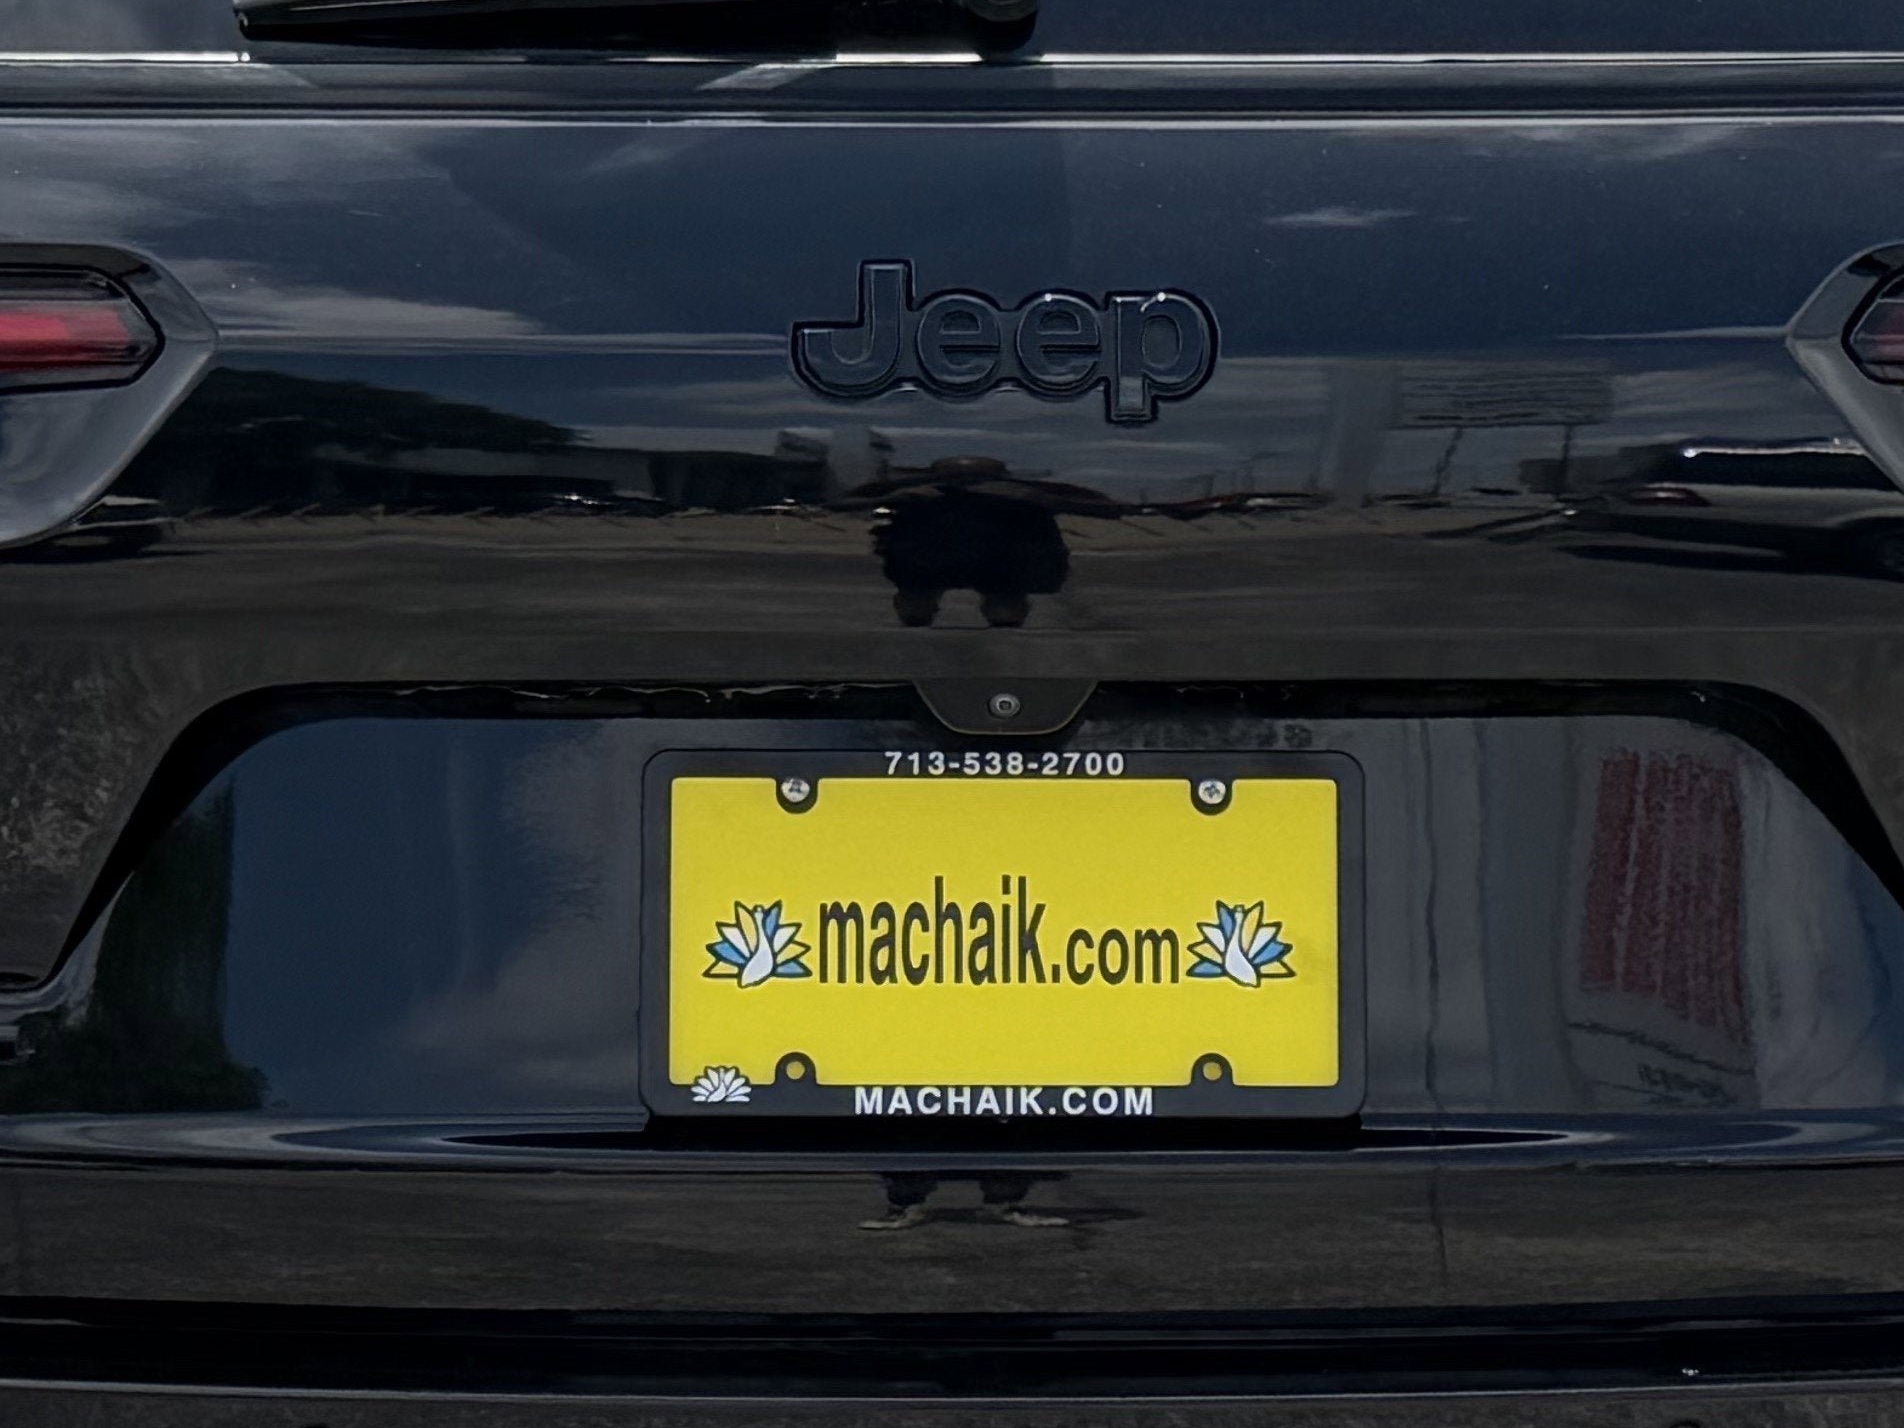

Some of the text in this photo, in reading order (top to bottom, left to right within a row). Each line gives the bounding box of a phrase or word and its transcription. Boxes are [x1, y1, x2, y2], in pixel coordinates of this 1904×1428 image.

[791, 259, 1219, 427] Jeep
[883, 751, 1126, 777] 713-538-2700
[817, 875, 1180, 986] machaik.com
[852, 1086, 1155, 1117] MACHAIK.COM
